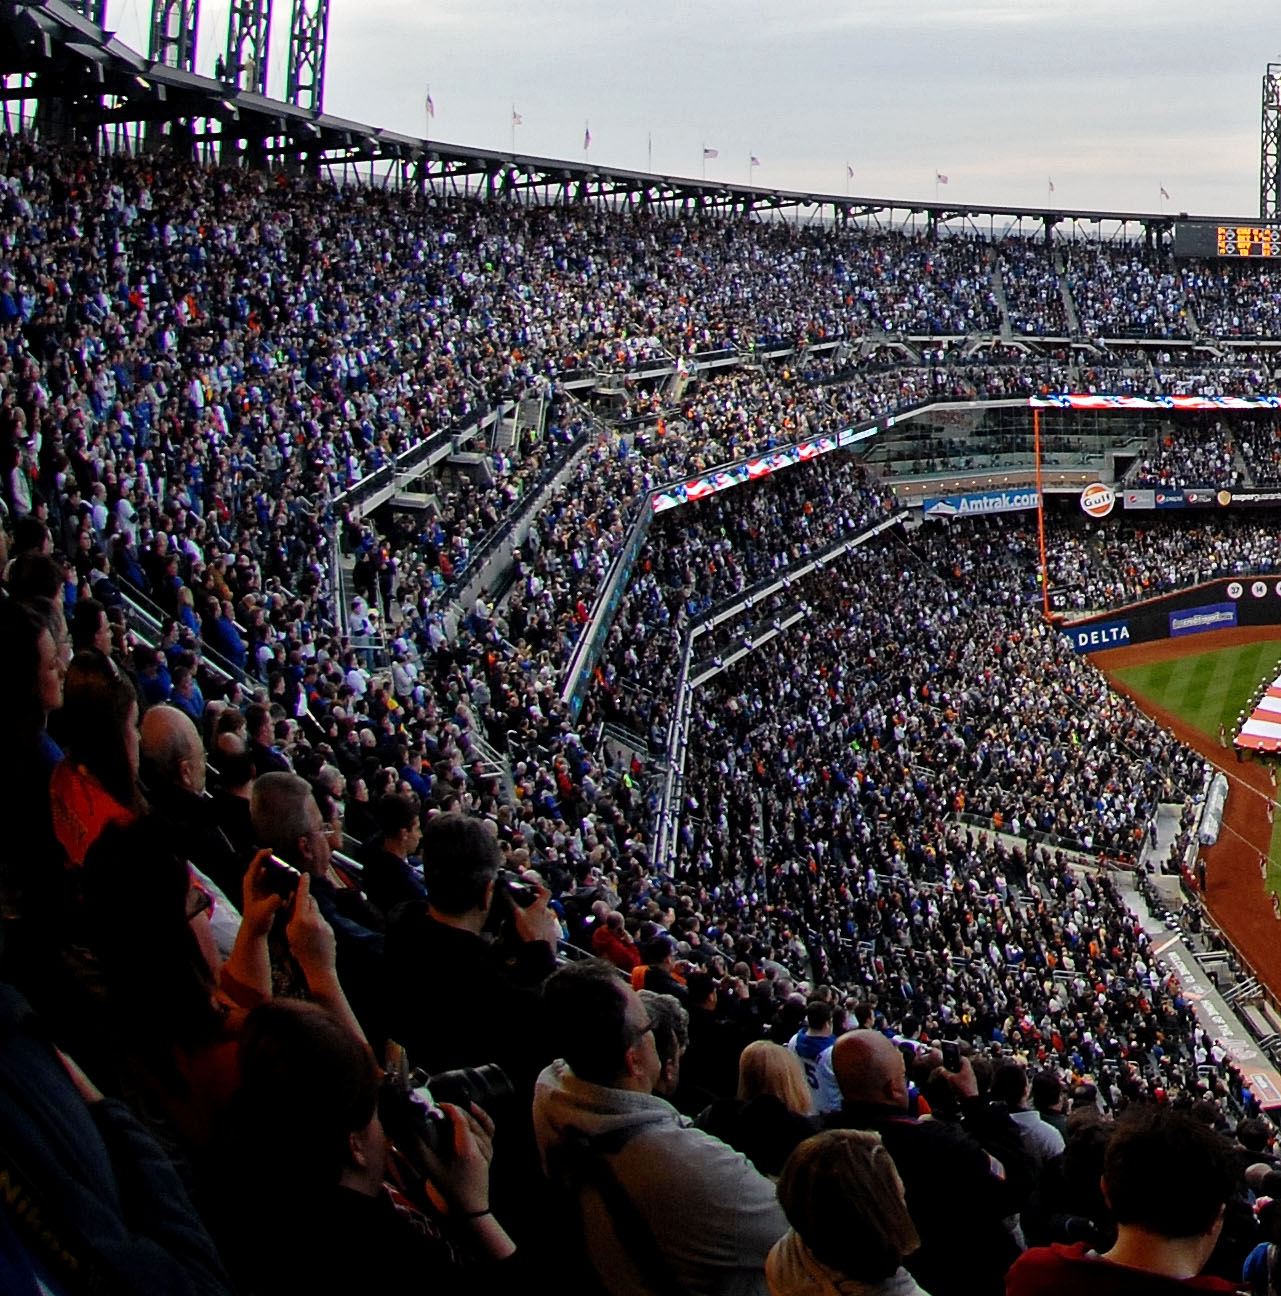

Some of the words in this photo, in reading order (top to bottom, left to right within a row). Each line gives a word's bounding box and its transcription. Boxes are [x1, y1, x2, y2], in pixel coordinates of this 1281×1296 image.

[959, 493, 1040, 513] Amtrak.com
[1084, 493, 1111, 507] Gulf
[1231, 586, 1239, 594] 37
[1255, 585, 1263, 593] 14
[1078, 625, 1130, 646] DELTA
